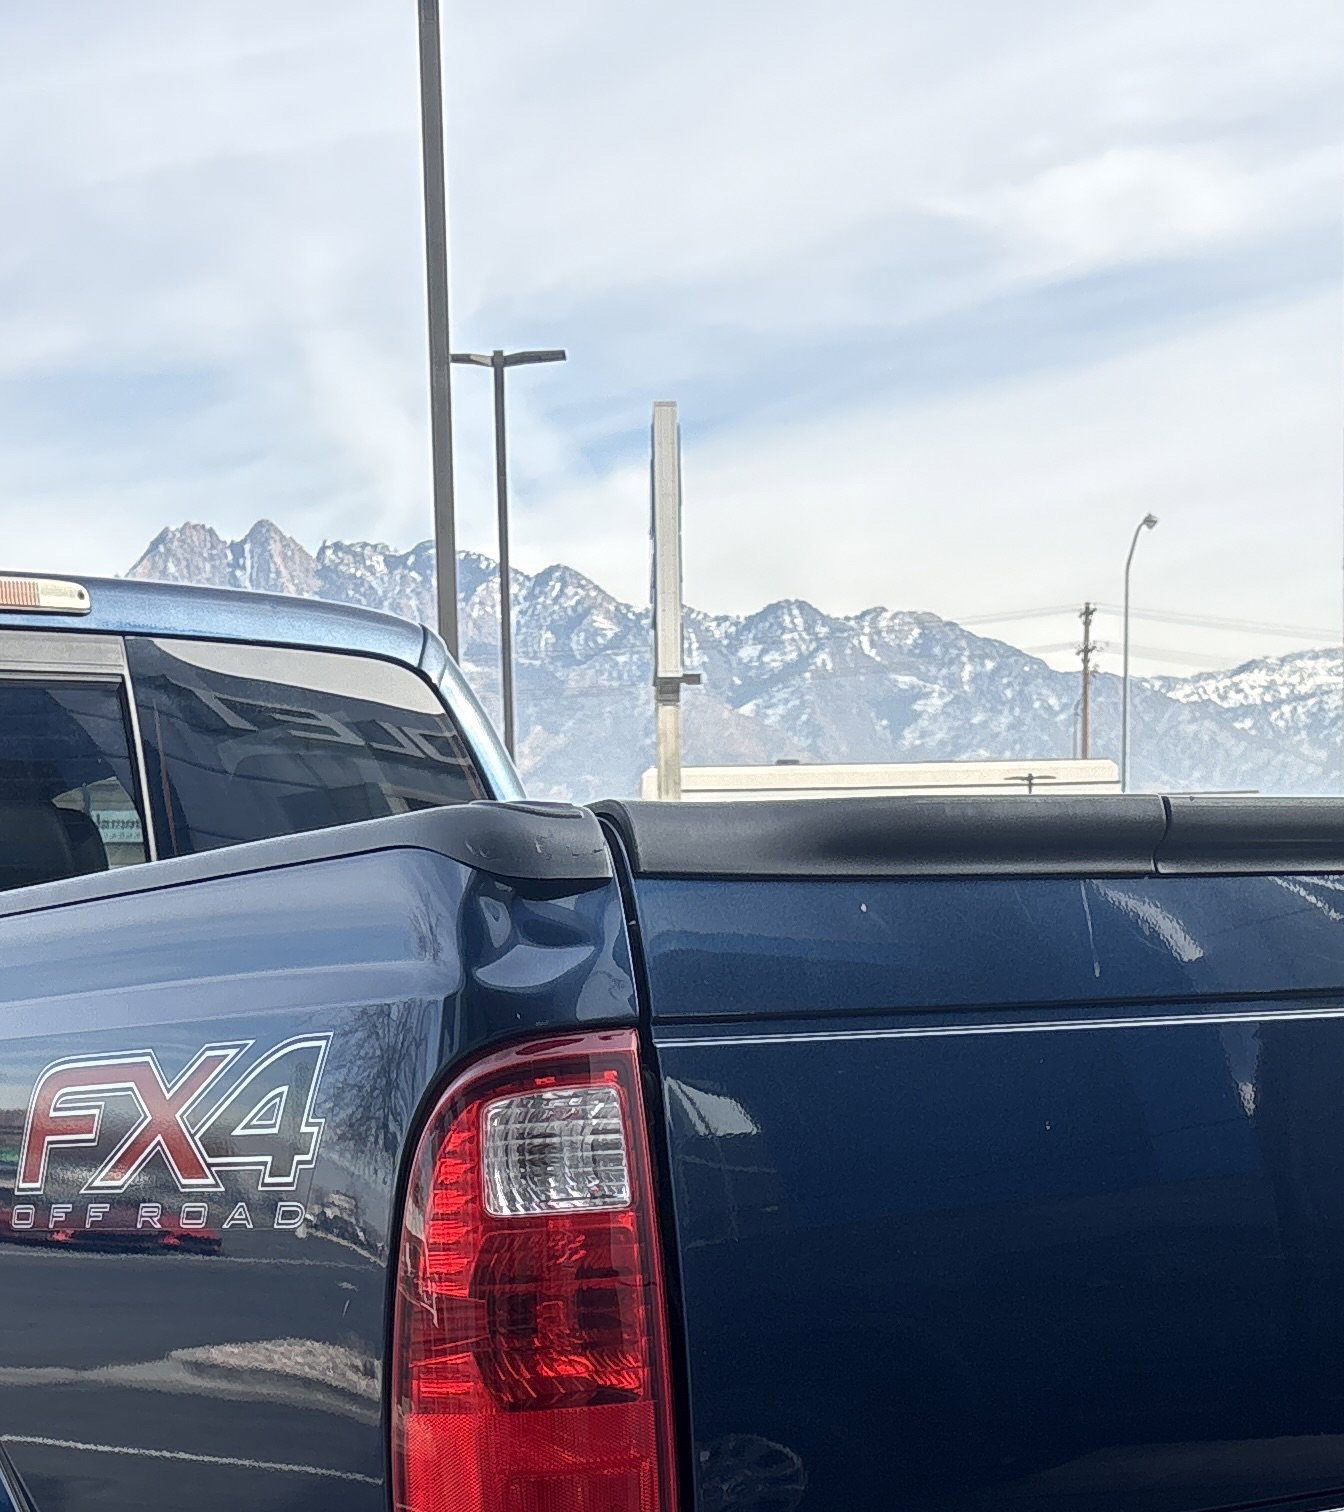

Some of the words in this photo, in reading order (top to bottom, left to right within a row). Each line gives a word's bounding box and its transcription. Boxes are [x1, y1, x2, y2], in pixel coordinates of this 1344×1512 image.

[13, 1031, 335, 1195] FX4
[11, 1203, 111, 1230] OFF
[136, 1201, 306, 1230] ROAD
